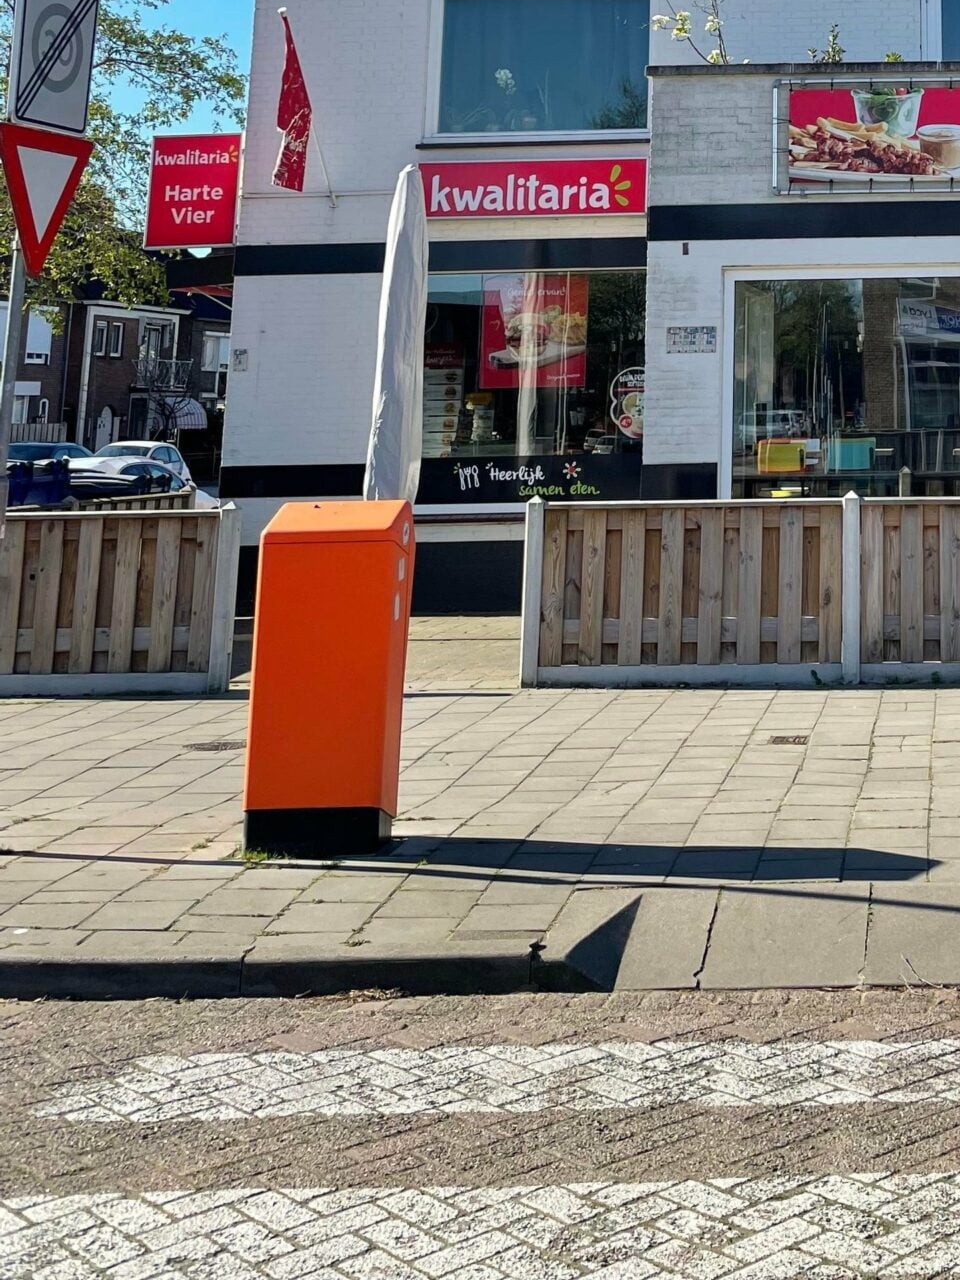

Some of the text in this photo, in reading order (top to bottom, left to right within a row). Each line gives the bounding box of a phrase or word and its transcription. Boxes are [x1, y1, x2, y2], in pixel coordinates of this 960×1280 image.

[154, 149, 230, 166] kwalitaria
[164, 185, 224, 202] Harte
[430, 174, 611, 213] kwalitaria
[171, 207, 215, 225] Vier
[489, 465, 546, 486] Heerlijk
[518, 484, 565, 497] samen
